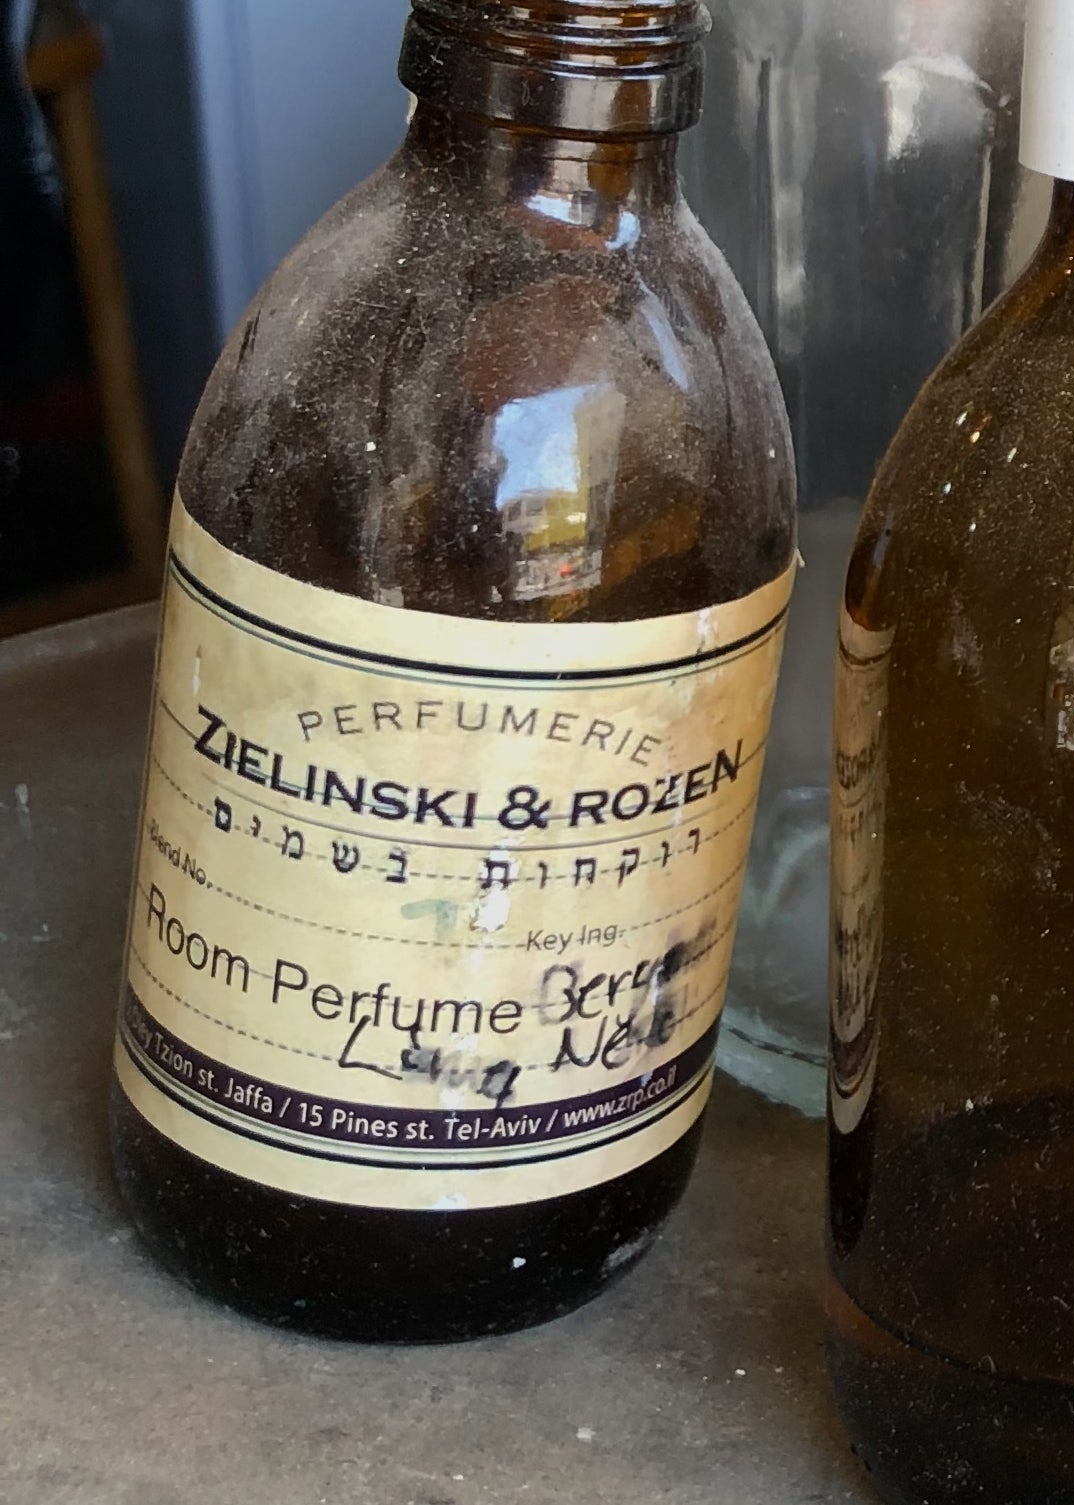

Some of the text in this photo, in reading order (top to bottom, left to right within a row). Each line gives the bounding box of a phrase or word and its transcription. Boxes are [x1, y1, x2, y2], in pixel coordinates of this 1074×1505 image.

[194, 705, 477, 829] ZIELINSKI
[497, 784, 552, 831] &
[569, 739, 745, 828] ROZEN
[298, 699, 662, 768] PERFUMERIE
[147, 881, 522, 1034] Room Perfume
[525, 928, 574, 955] Key
[154, 1031, 194, 1079] Tzion
[198, 1068, 219, 1093] st.
[224, 1077, 273, 1115] Jaffa
[299, 1102, 324, 1127] 15
[331, 1107, 399, 1139] Pines
[405, 1118, 435, 1141] st.
[444, 1113, 543, 1141] Tel-Aviv
